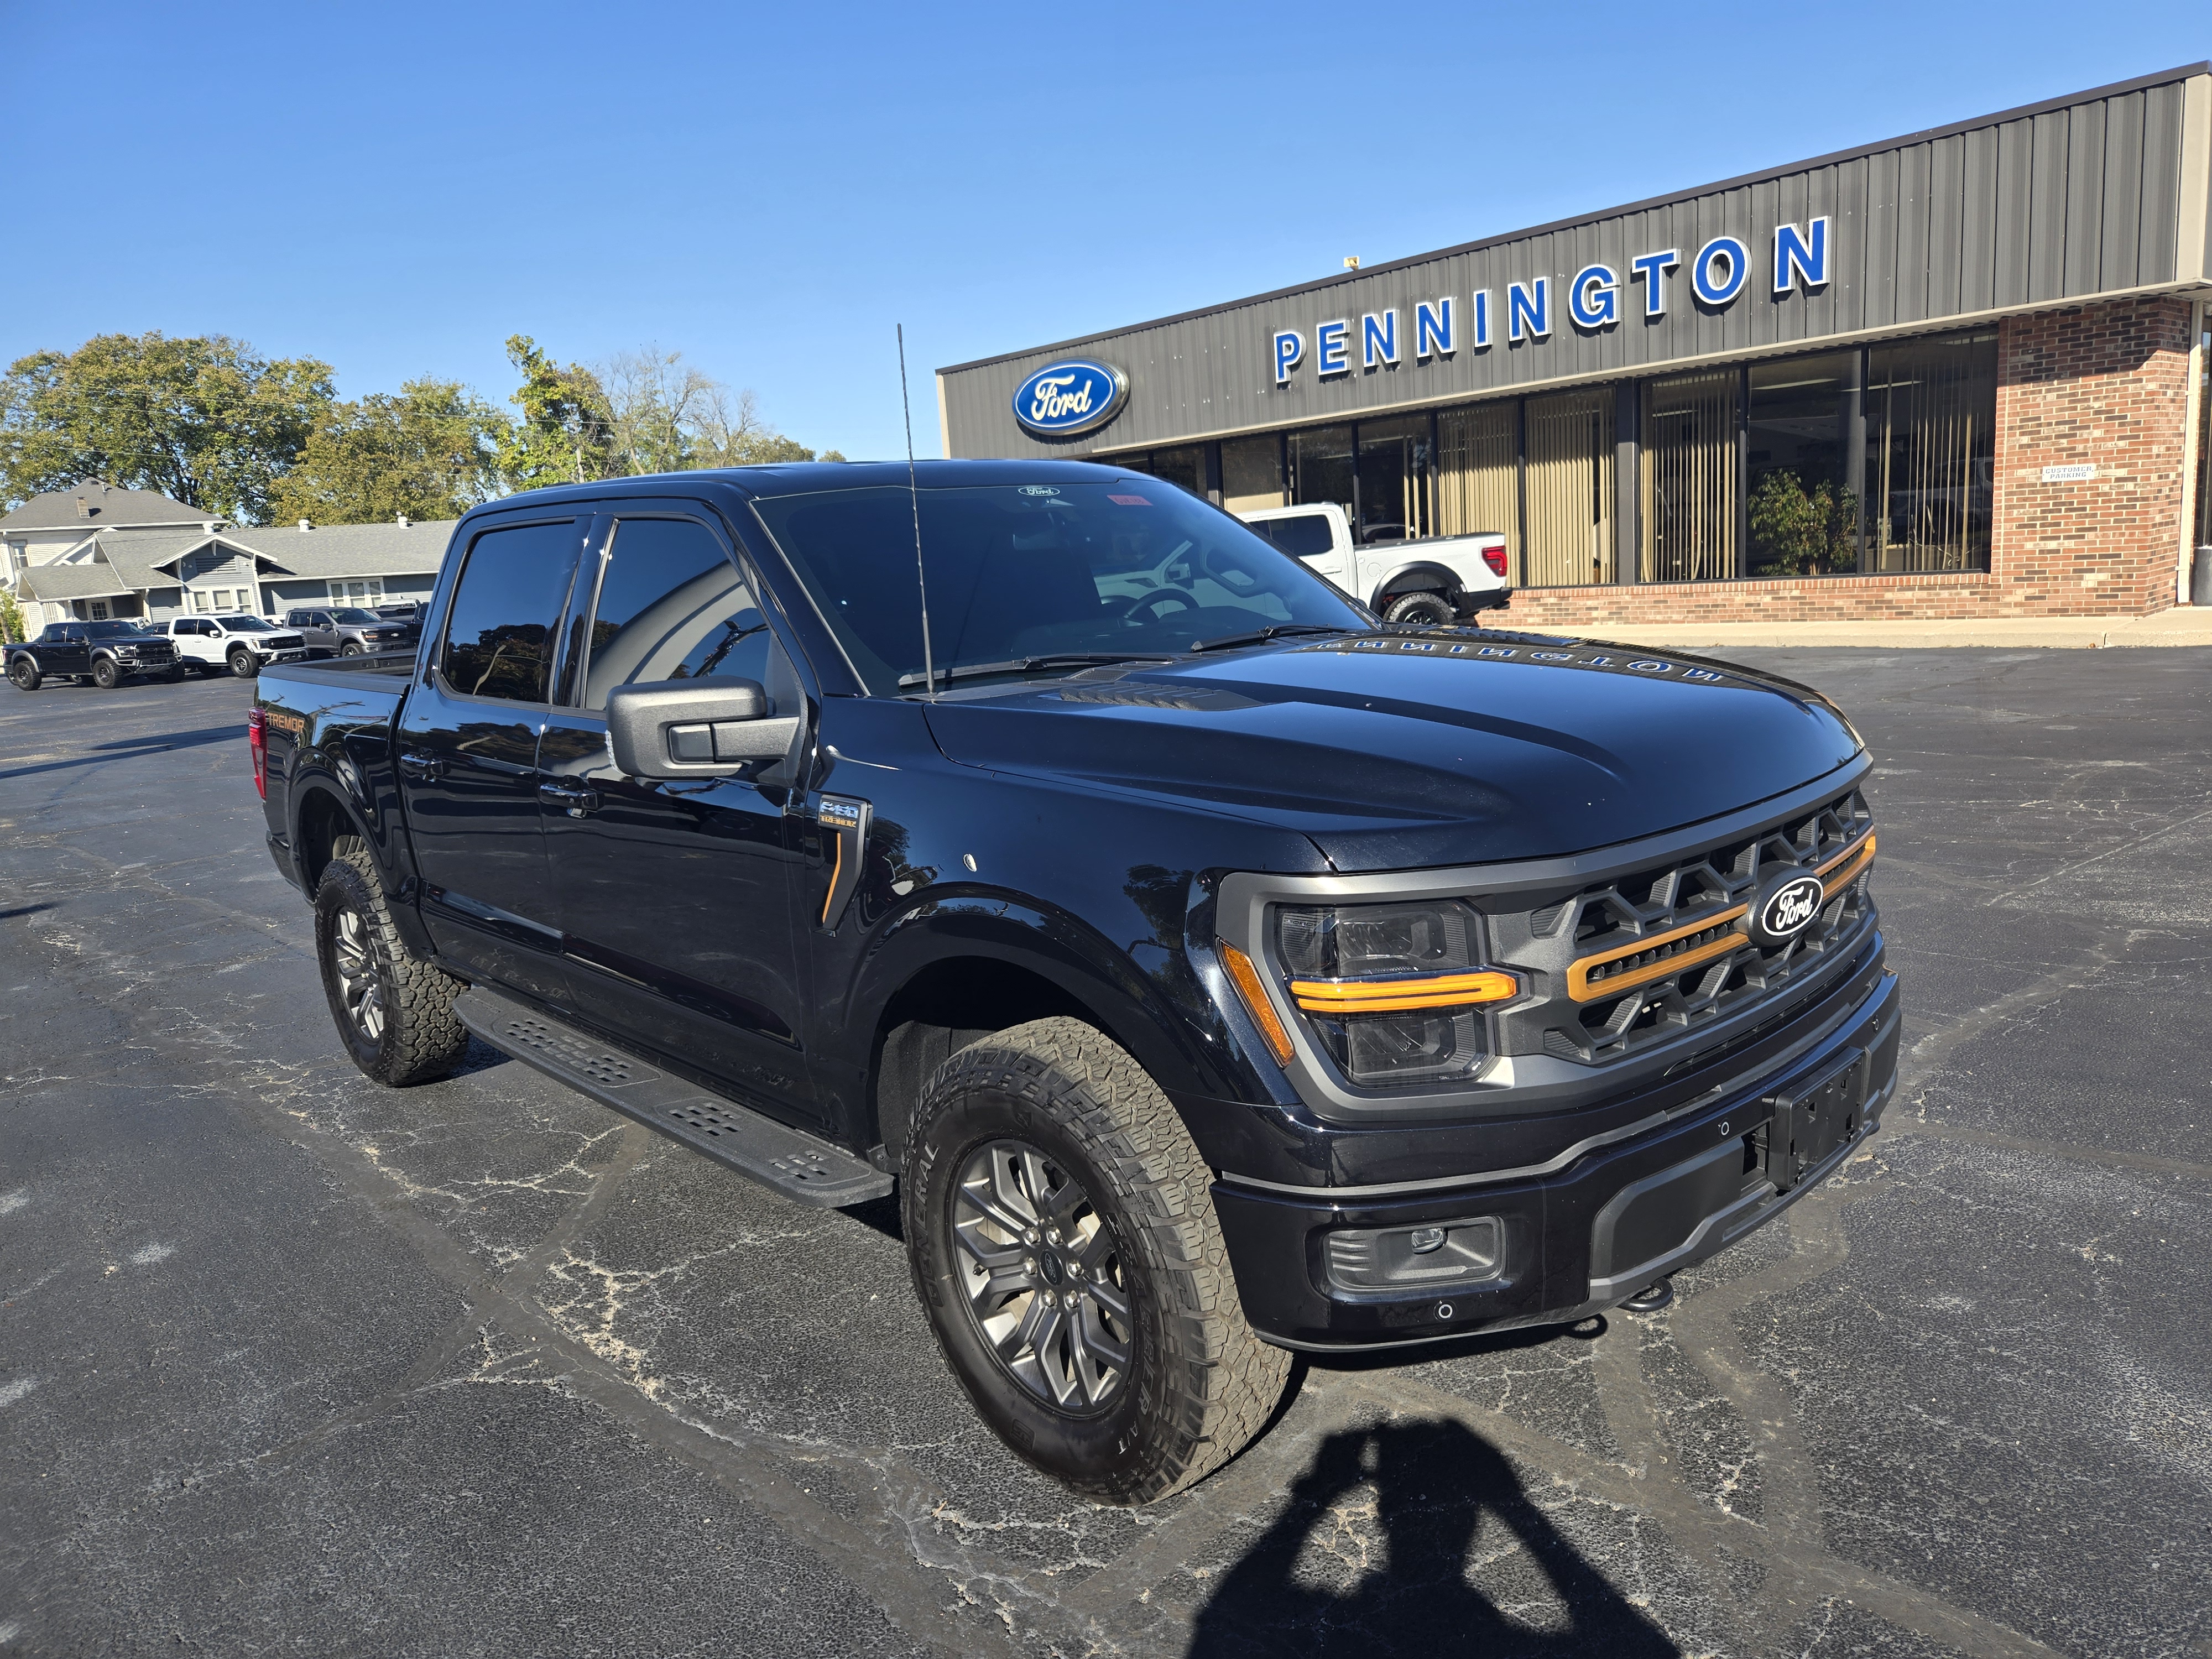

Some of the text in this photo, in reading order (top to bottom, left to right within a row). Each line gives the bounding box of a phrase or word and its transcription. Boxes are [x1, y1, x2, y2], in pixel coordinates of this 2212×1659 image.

[1273, 216, 1832, 383] PENNINGTON
[1031, 373, 1092, 421] Ford
[268, 712, 305, 733] TREMOR
[820, 802, 859, 818] F-150
[820, 815, 857, 828] TREMOR
[1776, 886, 1813, 930] Ford
[914, 1141, 944, 1307] GENERAL
